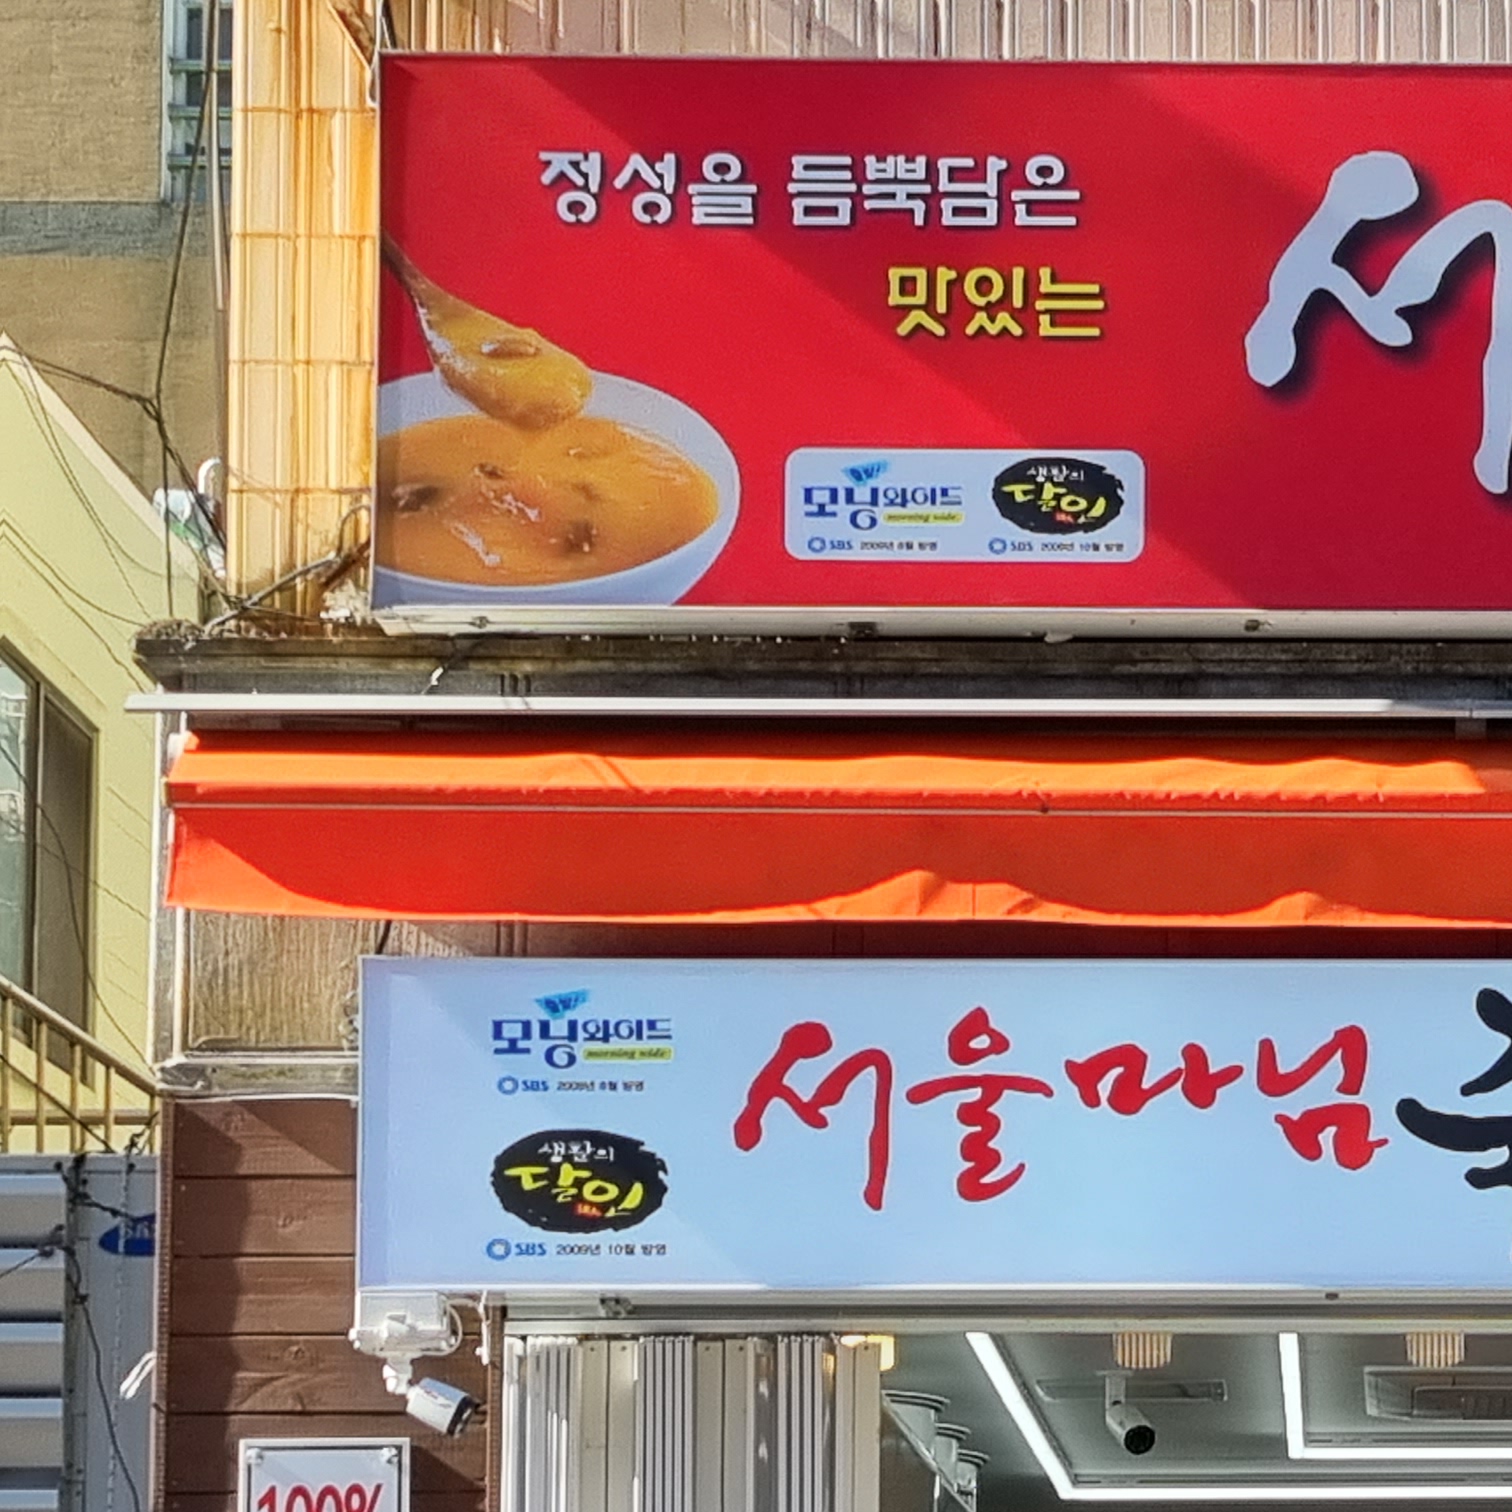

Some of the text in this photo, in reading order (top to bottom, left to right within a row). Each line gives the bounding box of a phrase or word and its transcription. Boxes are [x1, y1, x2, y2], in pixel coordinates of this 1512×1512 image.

[538, 150, 758, 226] 정성을
[887, 265, 1104, 338] 맛있는
[1001, 482, 1106, 524] 달인
[829, 540, 854, 551] SBS
[522, 1080, 549, 1091] SBS
[504, 1162, 643, 1217] 달인
[515, 1242, 547, 1256] SBS
